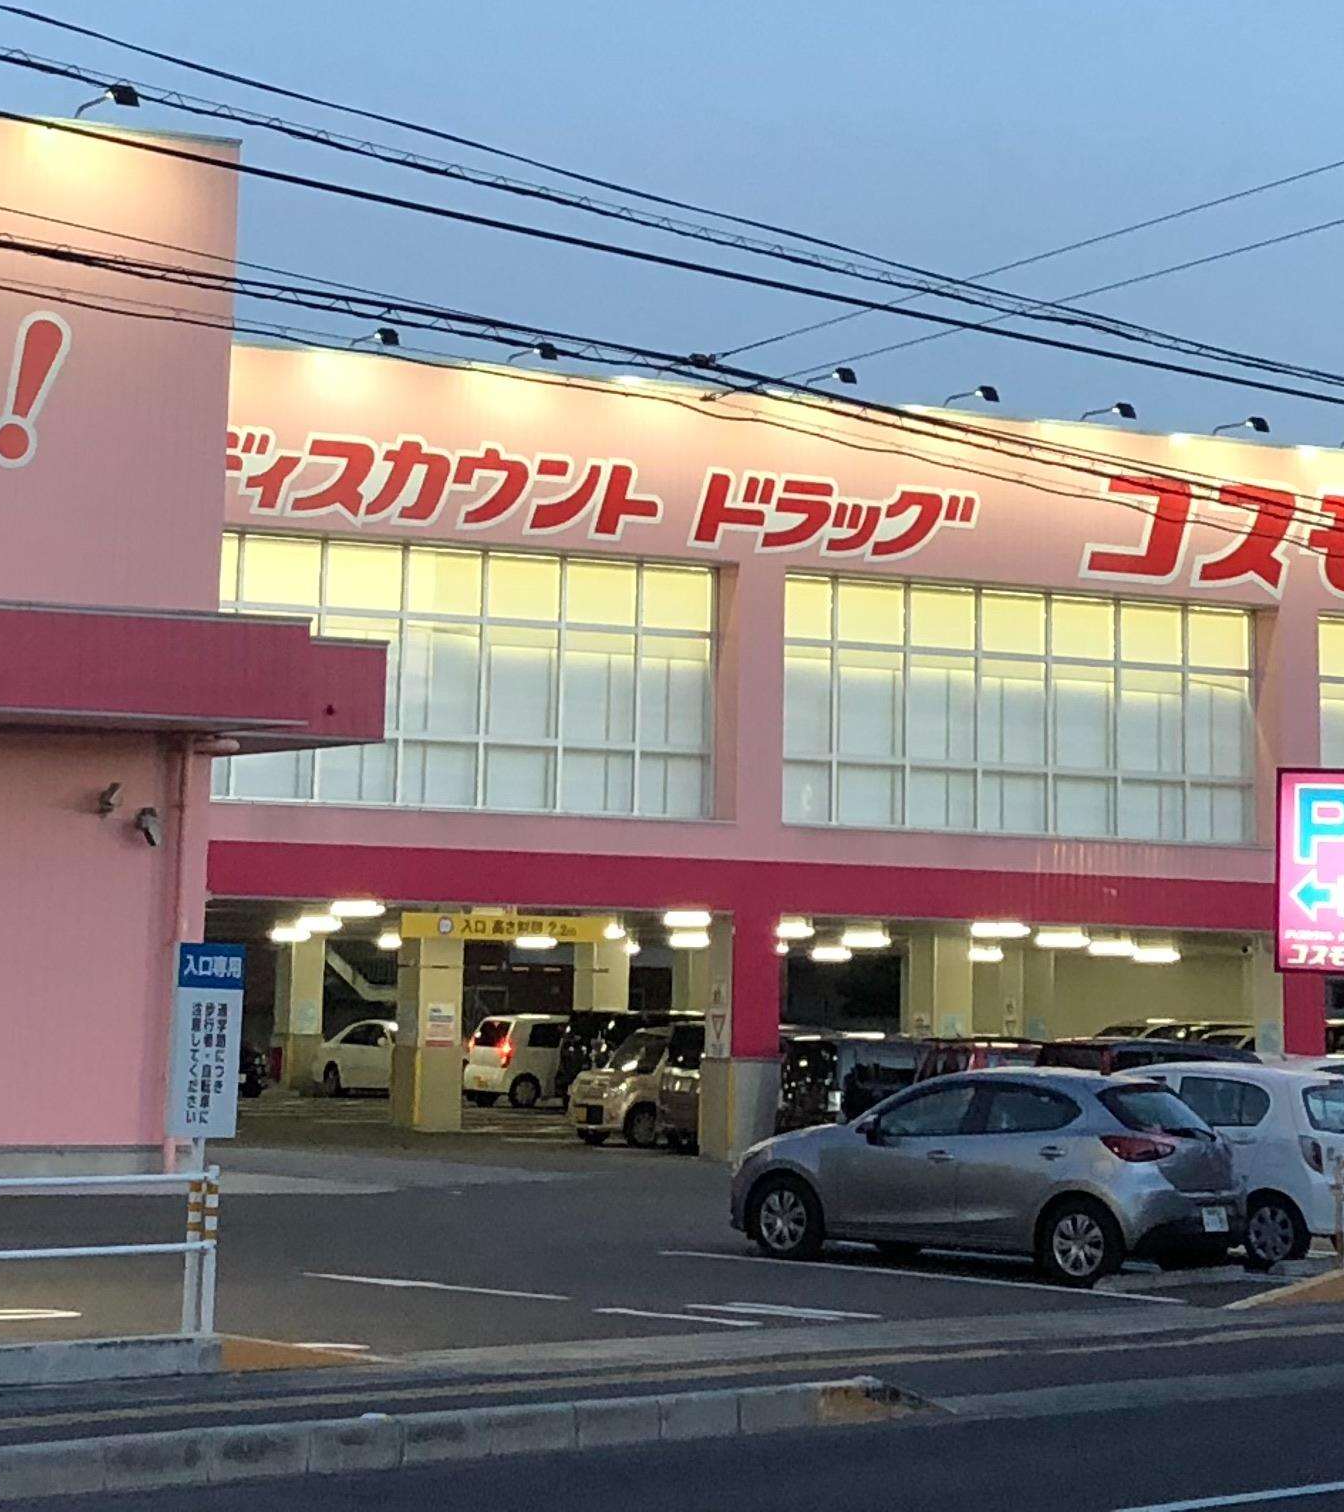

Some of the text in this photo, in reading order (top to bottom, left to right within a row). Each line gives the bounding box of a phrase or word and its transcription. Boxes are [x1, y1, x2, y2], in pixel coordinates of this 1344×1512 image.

[688, 465, 980, 563] ドラッグ
[183, 953, 242, 979] 入口専用
